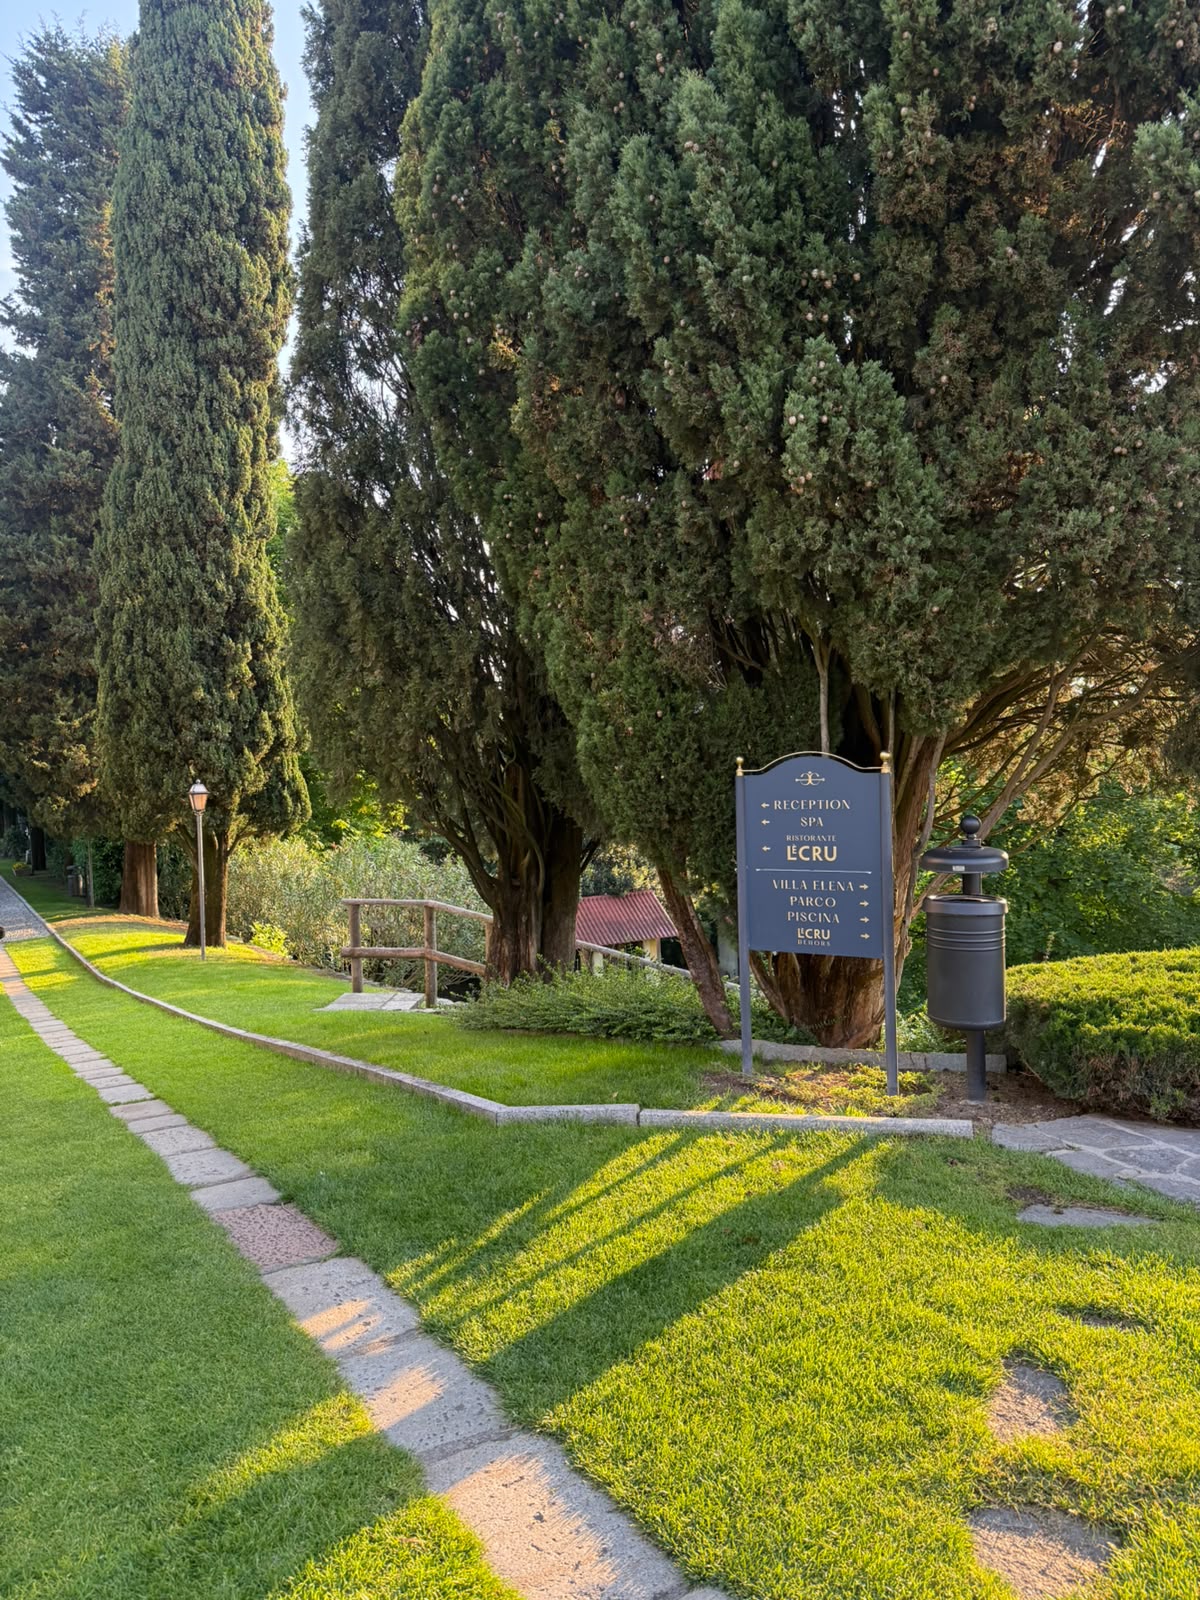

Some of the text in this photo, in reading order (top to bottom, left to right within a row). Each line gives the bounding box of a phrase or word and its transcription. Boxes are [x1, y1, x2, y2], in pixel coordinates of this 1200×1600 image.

[773, 799, 851, 810] RECEPTION
[800, 817, 823, 827] SPA
[772, 879, 854, 892] VILLA ELENA
[789, 896, 836, 908] PARCO
[787, 911, 840, 924] PISCINA
